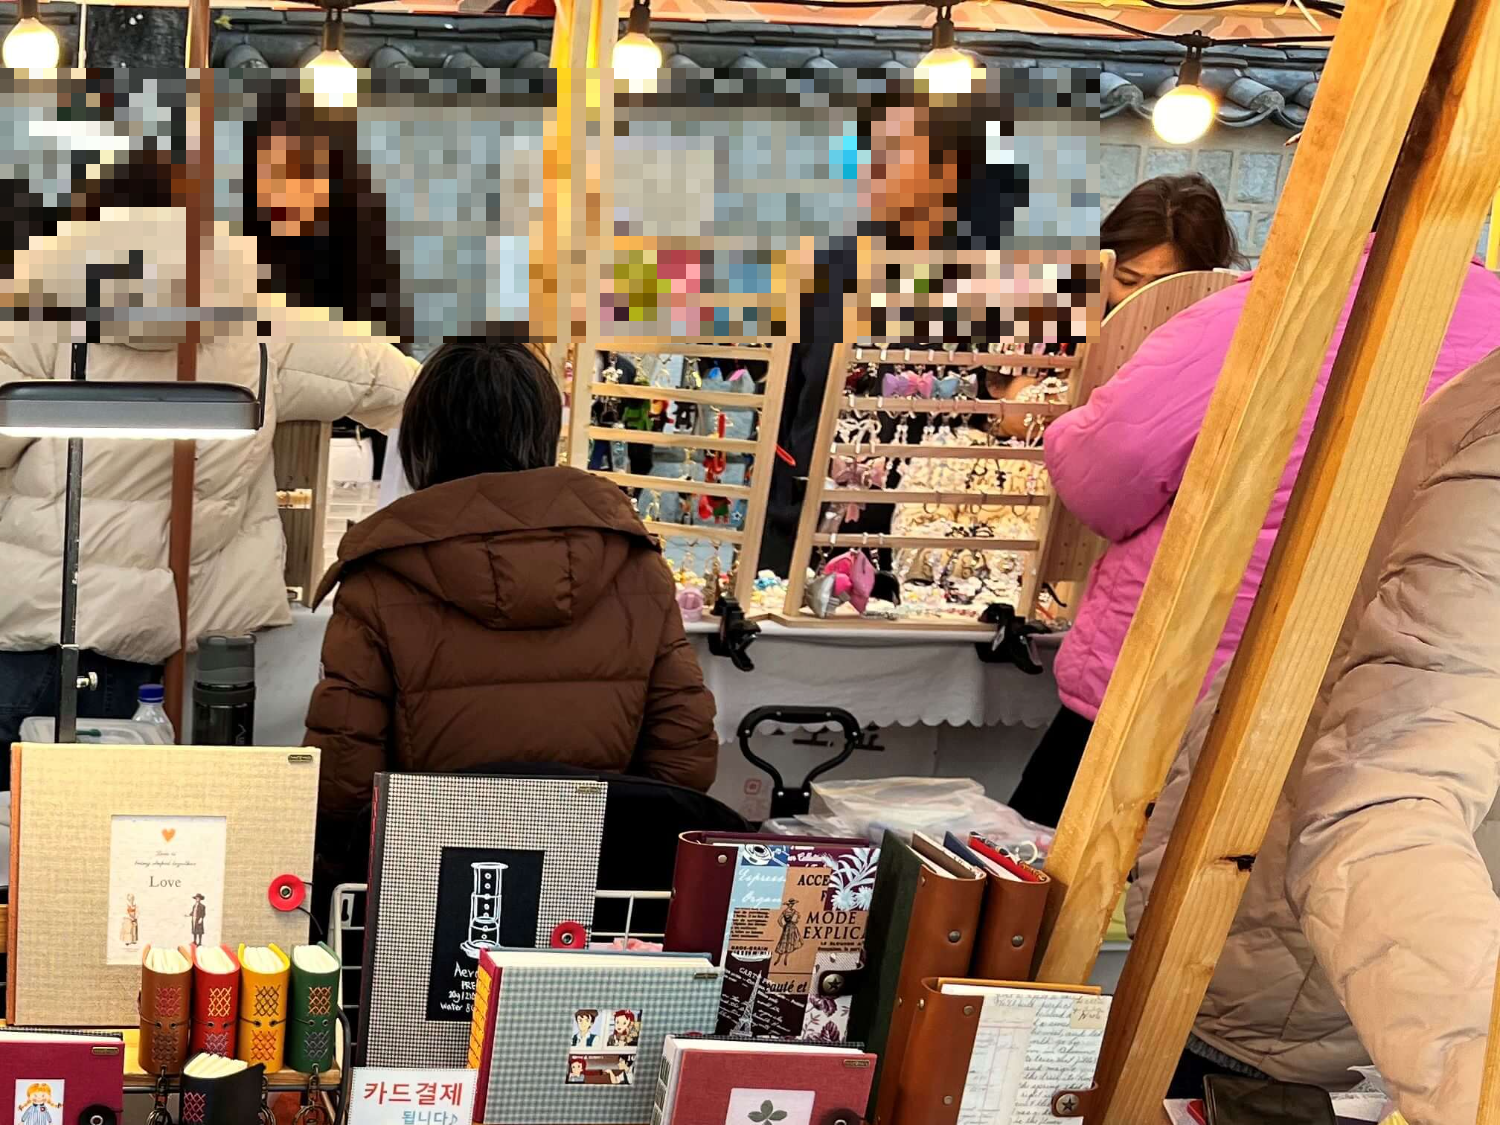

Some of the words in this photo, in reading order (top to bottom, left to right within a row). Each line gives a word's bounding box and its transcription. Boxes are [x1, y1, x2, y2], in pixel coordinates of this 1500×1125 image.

[149, 875, 182, 888] Love
[806, 911, 857, 925] MODE
[363, 1081, 463, 1107] 카드결제
